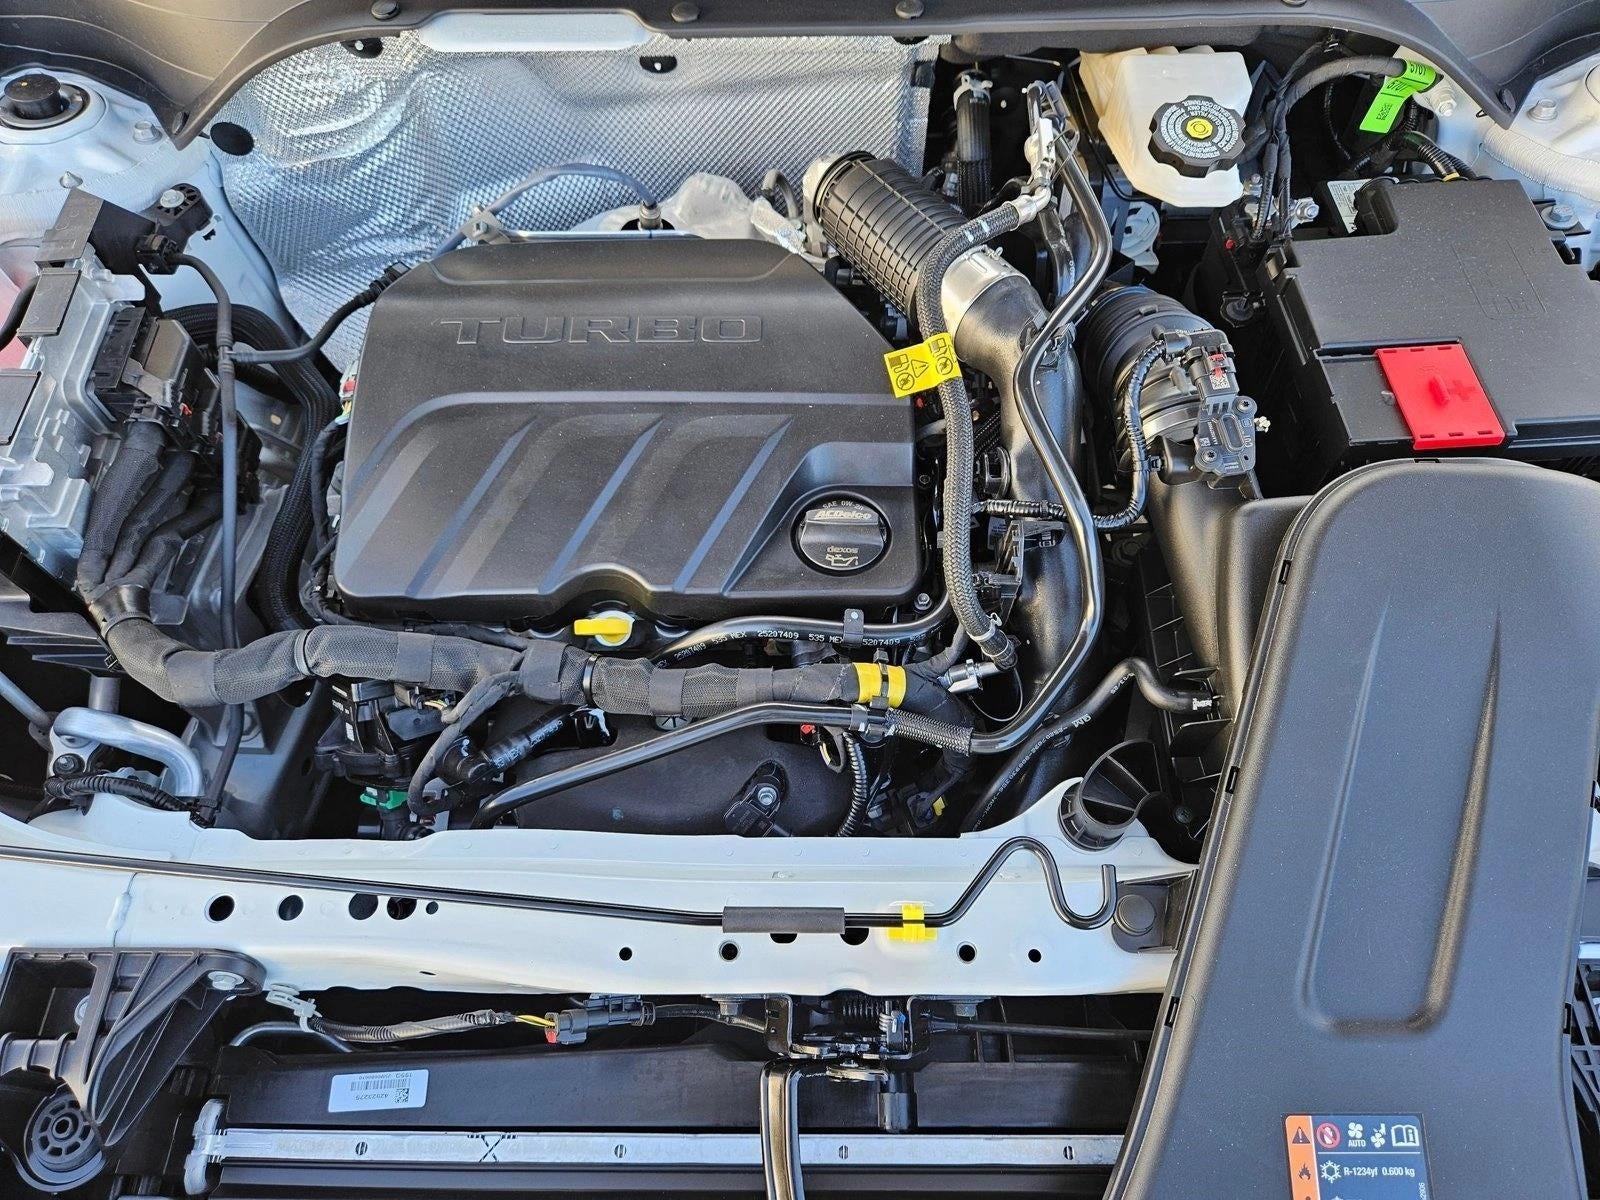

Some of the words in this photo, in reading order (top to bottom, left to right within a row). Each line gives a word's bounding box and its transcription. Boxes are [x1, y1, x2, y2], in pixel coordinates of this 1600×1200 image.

[431, 317, 762, 344] TURBO
[822, 501, 838, 510] SAE
[814, 510, 872, 520] ACDelco
[826, 546, 859, 554] dexos
[758, 630, 800, 640] 25207409
[808, 632, 825, 642] 535
[862, 638, 901, 646] 5207409
[1348, 1140, 1366, 1148] AUTO
[1344, 1166, 1378, 1178] R-1234yf
[1382, 1166, 1404, 1176] 0.600
[1405, 1166, 1416, 1178] kg
